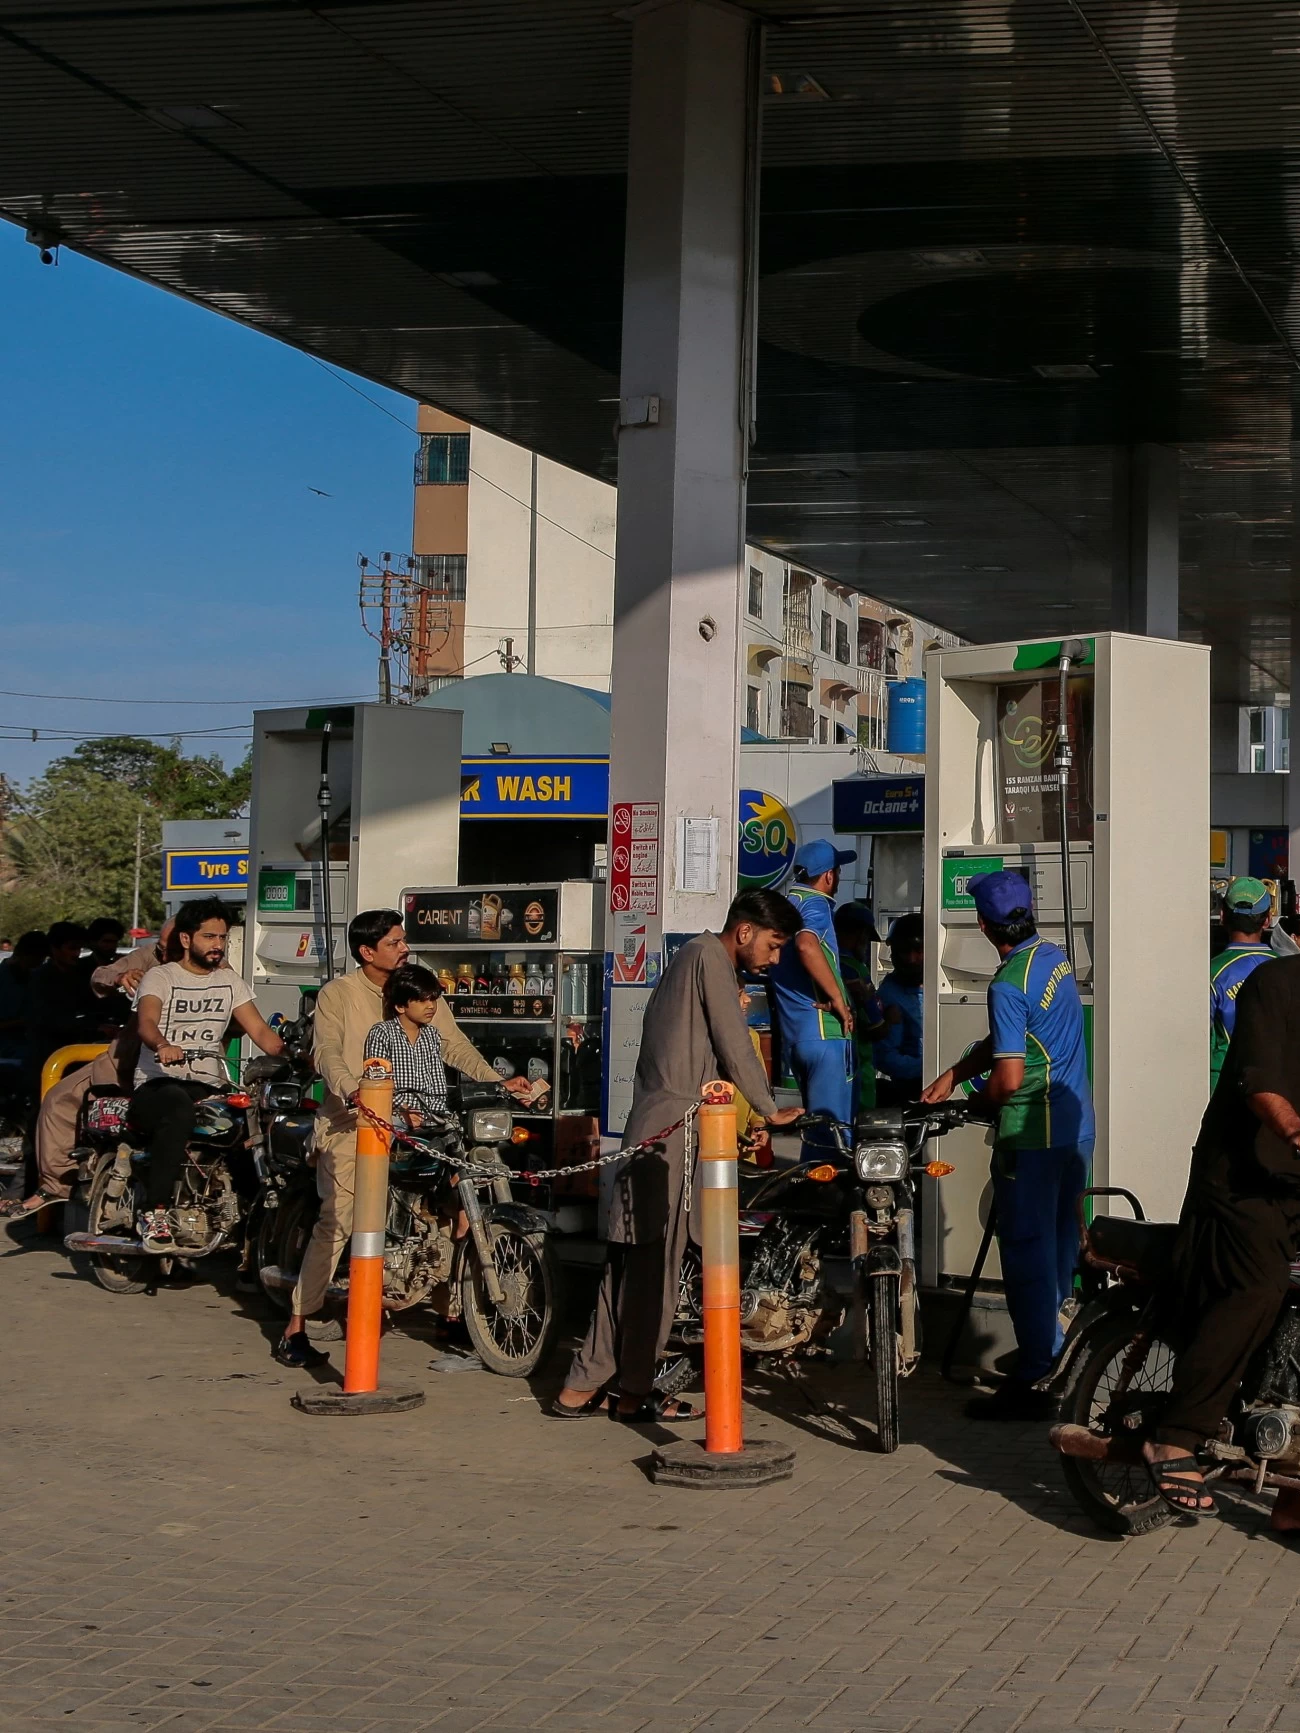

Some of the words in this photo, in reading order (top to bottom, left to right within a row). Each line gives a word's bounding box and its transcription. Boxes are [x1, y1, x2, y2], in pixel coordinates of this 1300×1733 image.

[1005, 776, 1016, 785] ISS
[1017, 775, 1042, 784] RAMZAN
[496, 775, 572, 801] WASH
[1005, 786, 1030, 795] TARAQQI
[1030, 785, 1040, 793] KA
[885, 789, 903, 798] Euro
[639, 809, 658, 817] Smoking
[648, 843, 656, 851] off
[632, 852, 648, 860] engine
[198, 861, 230, 879] Tyre
[631, 881, 647, 889] Switch
[417, 909, 463, 925] CARIENT
[1040, 975, 1058, 1011] HAPPY
[1057, 960, 1072, 977] HEL
[175, 998, 225, 1014] BUZZ
[171, 1029, 214, 1042] ING
